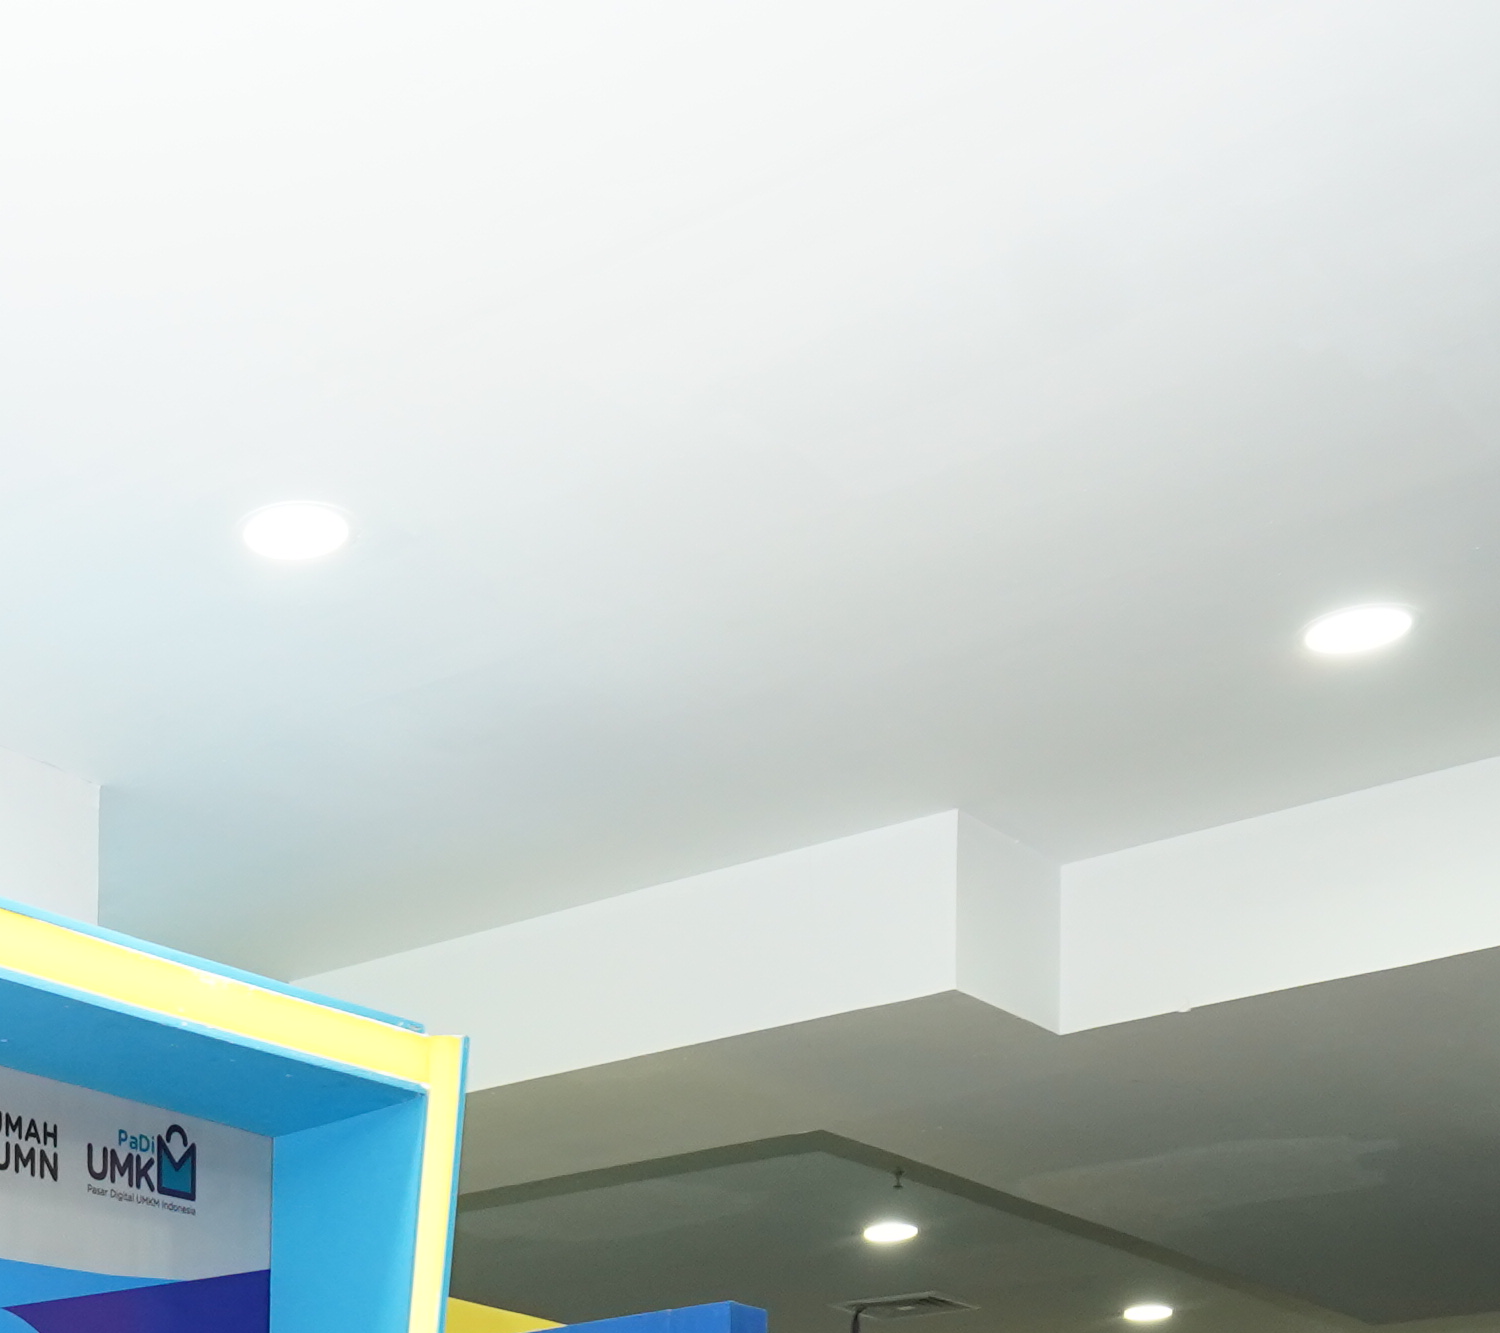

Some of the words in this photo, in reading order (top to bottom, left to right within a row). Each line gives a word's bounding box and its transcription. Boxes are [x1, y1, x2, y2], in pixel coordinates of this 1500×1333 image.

[118, 1128, 155, 1155] PaDi
[86, 1183, 108, 1197] Pasar
[110, 1188, 135, 1202] Digital
[161, 1200, 197, 1217] Indonesia
